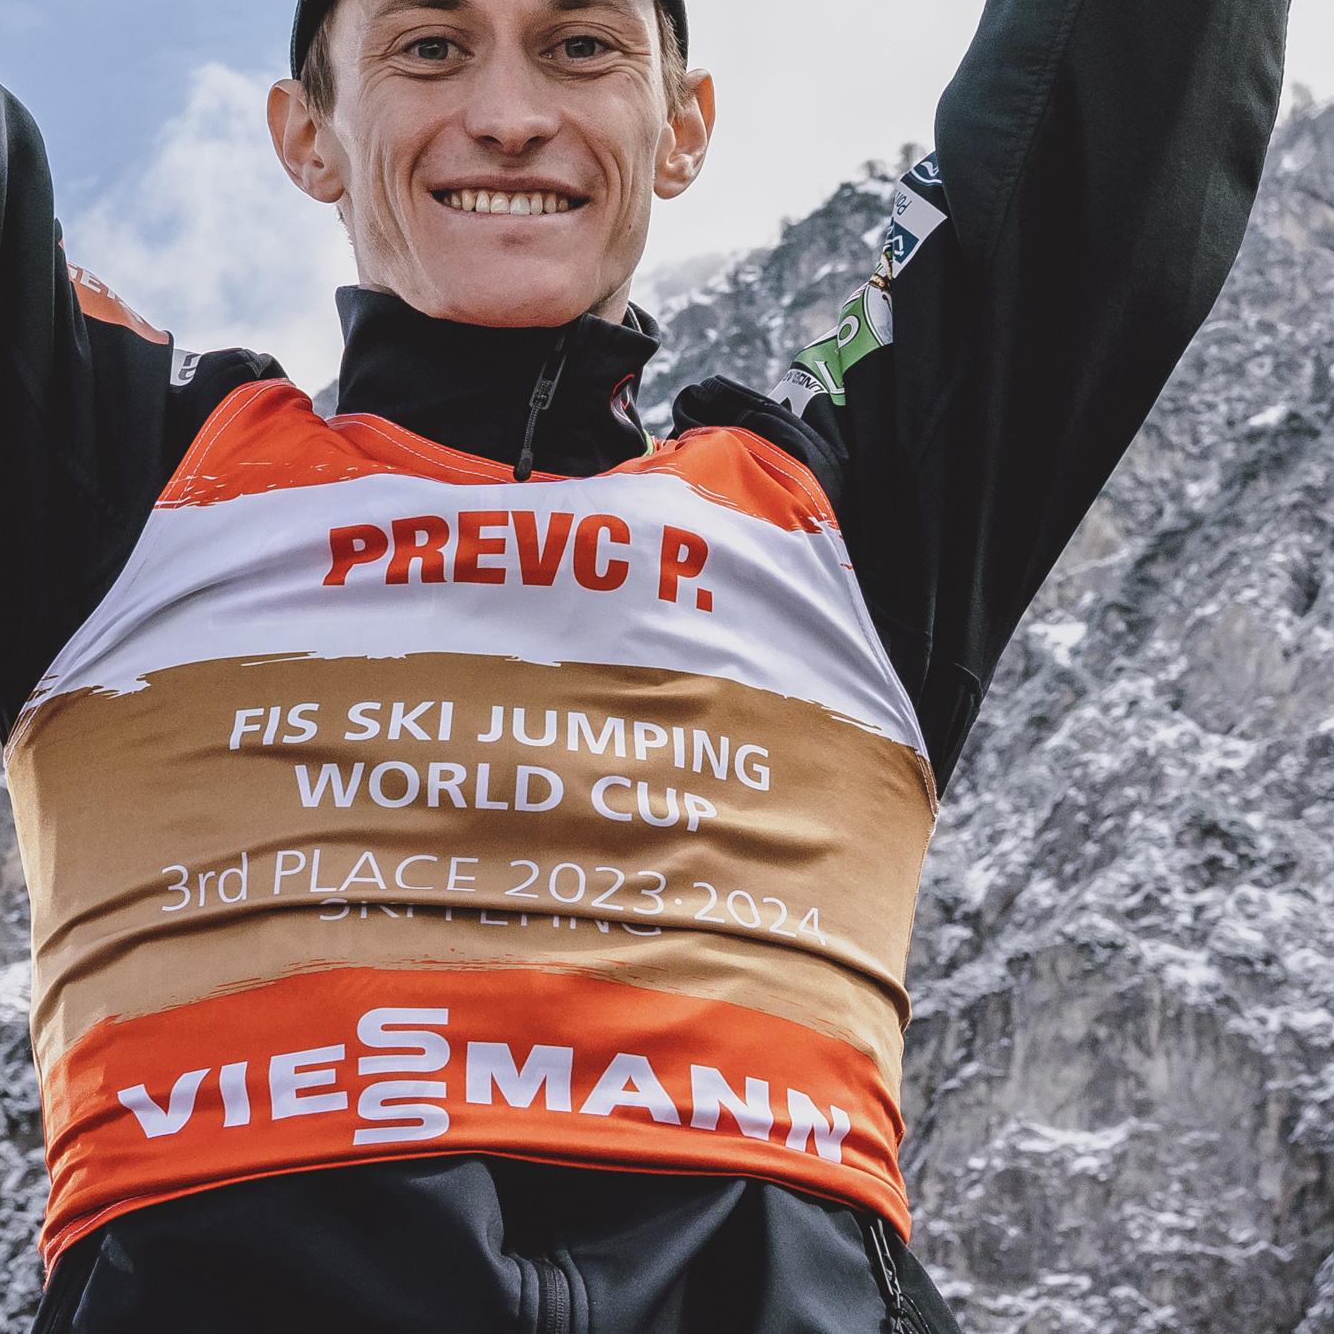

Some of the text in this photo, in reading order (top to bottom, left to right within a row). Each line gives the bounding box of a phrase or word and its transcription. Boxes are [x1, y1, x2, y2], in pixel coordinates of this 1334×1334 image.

[322, 510, 714, 613] PREVC P.
[229, 701, 770, 791] FIS SKI JUMPING
[294, 761, 718, 832] WORLD CUP
[161, 851, 249, 912] 3rd
[273, 849, 479, 895] PLACE
[117, 1007, 852, 1165] VIESSMANN
